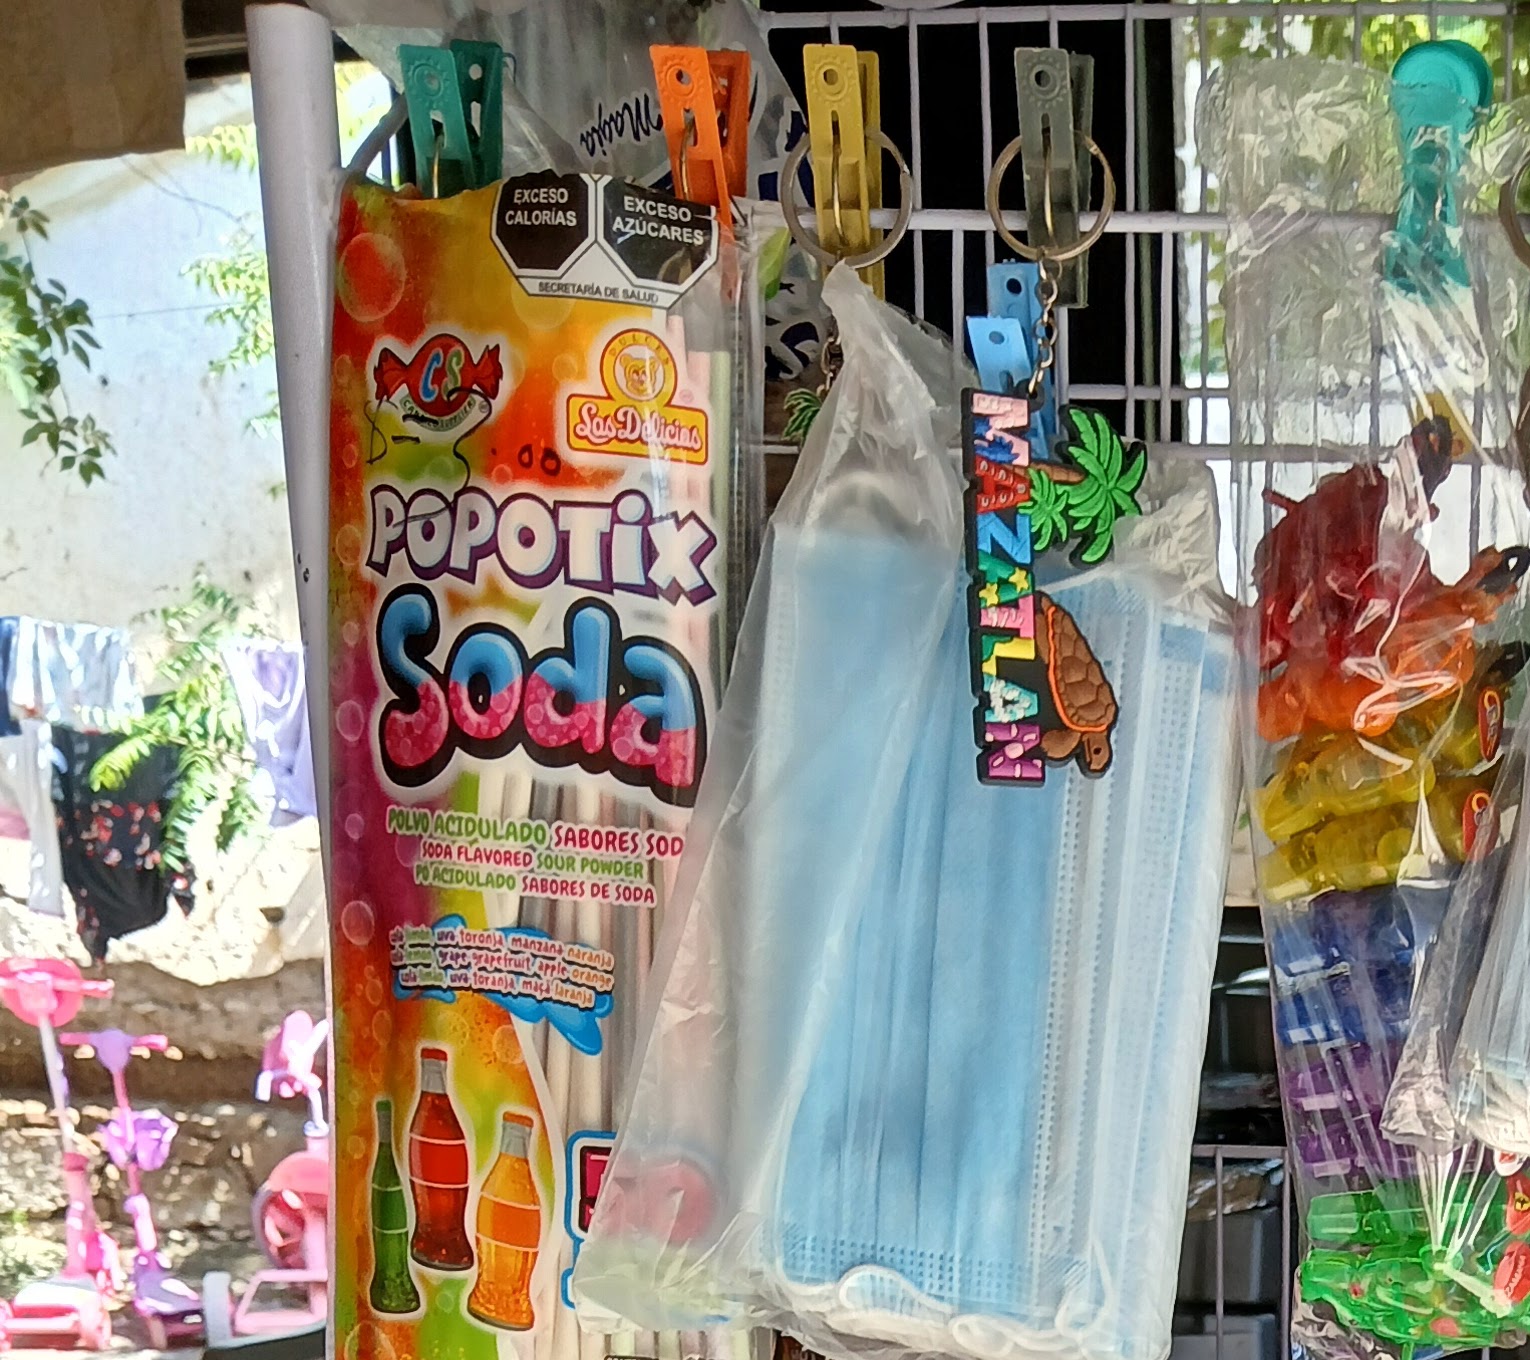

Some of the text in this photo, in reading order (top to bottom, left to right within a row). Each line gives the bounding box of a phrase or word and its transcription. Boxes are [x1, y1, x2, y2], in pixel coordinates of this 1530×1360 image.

[514, 188, 568, 204] EXCESO
[624, 196, 691, 222] EXCESO
[505, 209, 577, 227] CALORÍAS
[612, 216, 704, 246] AZÚCARES
[538, 282, 601, 297] SECRETARÍA
[604, 286, 619, 298] DE
[576, 403, 702, 451] Las Delicias
[375, 581, 707, 788] Soda
[388, 807, 430, 832] POLVO
[434, 812, 547, 845] ACIDULADO
[554, 827, 640, 852] SABORES
[421, 841, 645, 879] SODA FLAVORED SOUR POWDER
[432, 867, 516, 891] ACIDULADO
[522, 877, 586, 898] SABORES
[590, 884, 610, 900] DE
[615, 886, 655, 905] SODA
[436, 928, 613, 968] uva toronja manzana naranja
[438, 951, 613, 988] grape grapefruit apple orange
[450, 973, 469, 985] uva
[555, 983, 594, 1006] laranja
